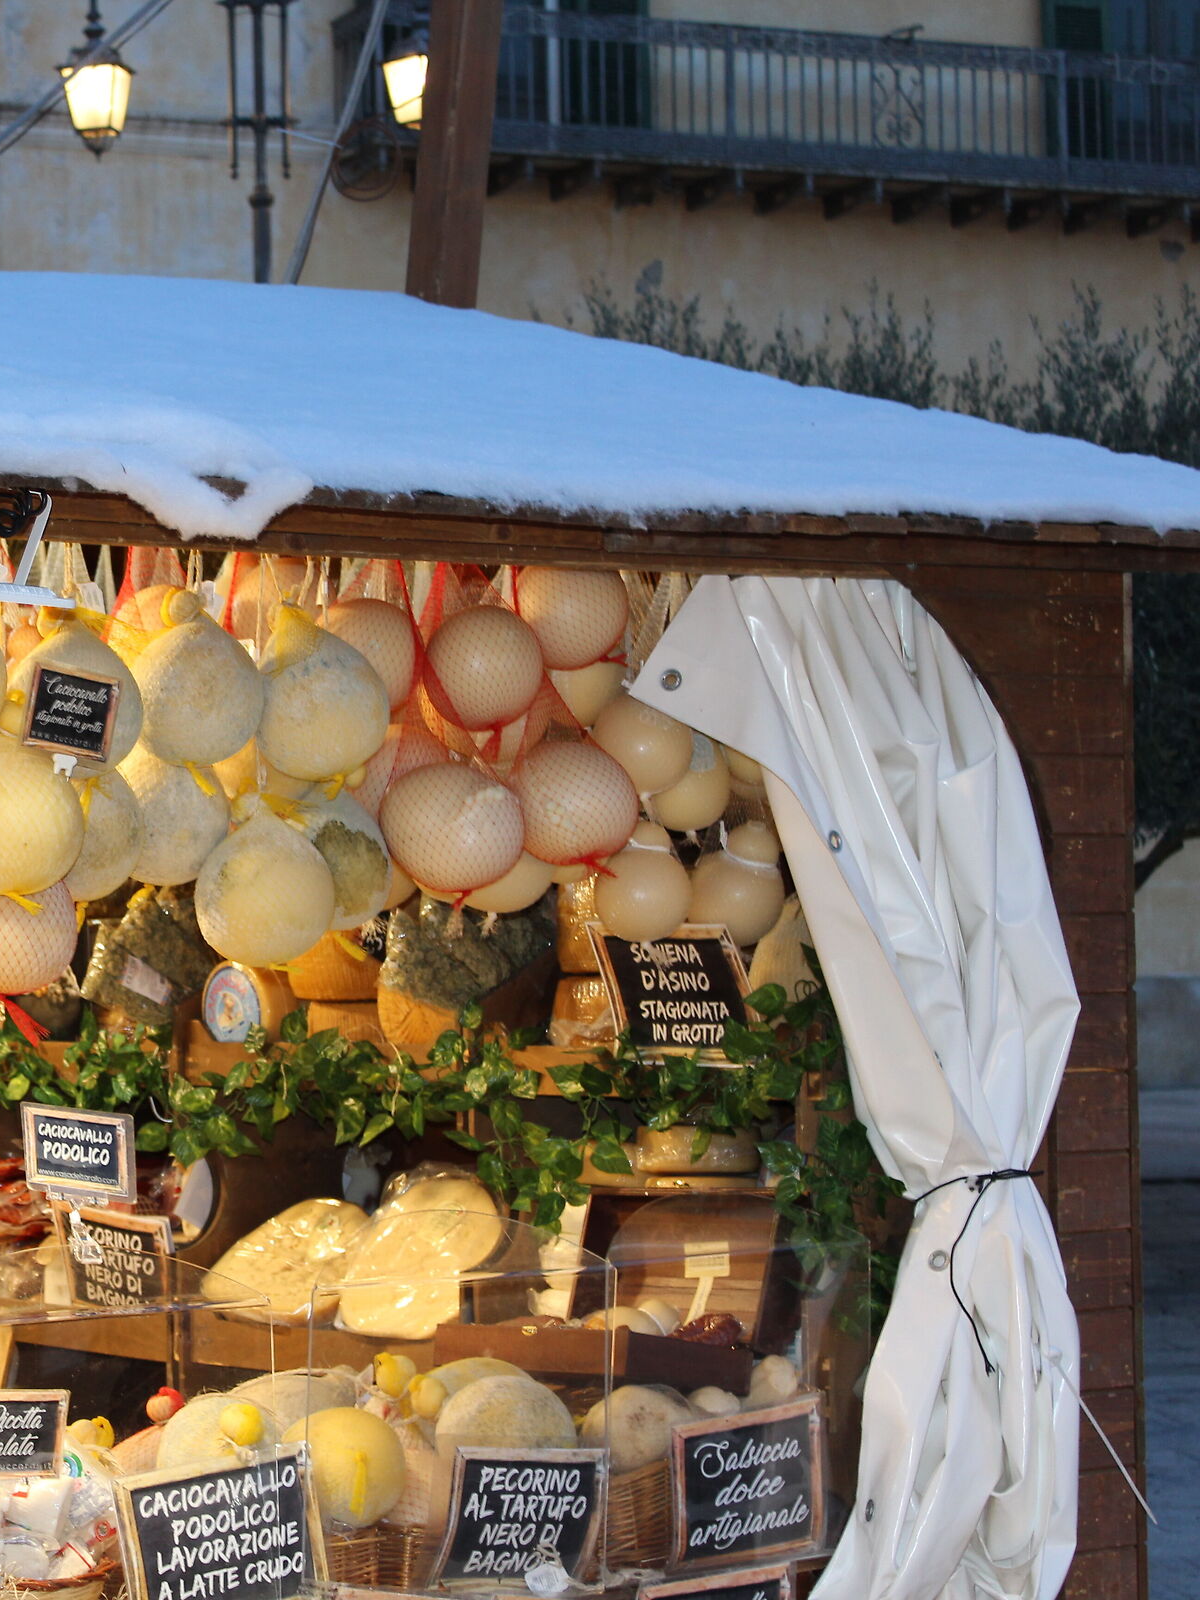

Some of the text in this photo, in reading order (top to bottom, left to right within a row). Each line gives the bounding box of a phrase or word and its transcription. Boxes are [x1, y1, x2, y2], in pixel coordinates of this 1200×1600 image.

[44, 675, 108, 704] Caciocavallo
[50, 698, 93, 717] podolico
[640, 969, 710, 994] D'ASINO
[639, 1000, 730, 1023] STAGIONATA
[652, 1023, 725, 1045] IN GROTTA
[37, 1122, 113, 1145] CACIOCAVALLO
[42, 1140, 110, 1166] PODOLICO
[85, 1262, 142, 1296] NERO DI
[694, 1437, 801, 1478] Salsiccia
[139, 1465, 296, 1518] CACIOCAVALLO
[479, 1466, 581, 1494] PECORINO
[715, 1469, 785, 1507] dolce
[464, 1493, 587, 1522] AL TARTUFO
[171, 1500, 276, 1545] PODOLICO
[479, 1523, 563, 1549] NERO DI
[690, 1495, 810, 1550] artigianale
[157, 1521, 300, 1575] LAVORAZIONE
[158, 1551, 304, 1600] A LATTE CRUDO
